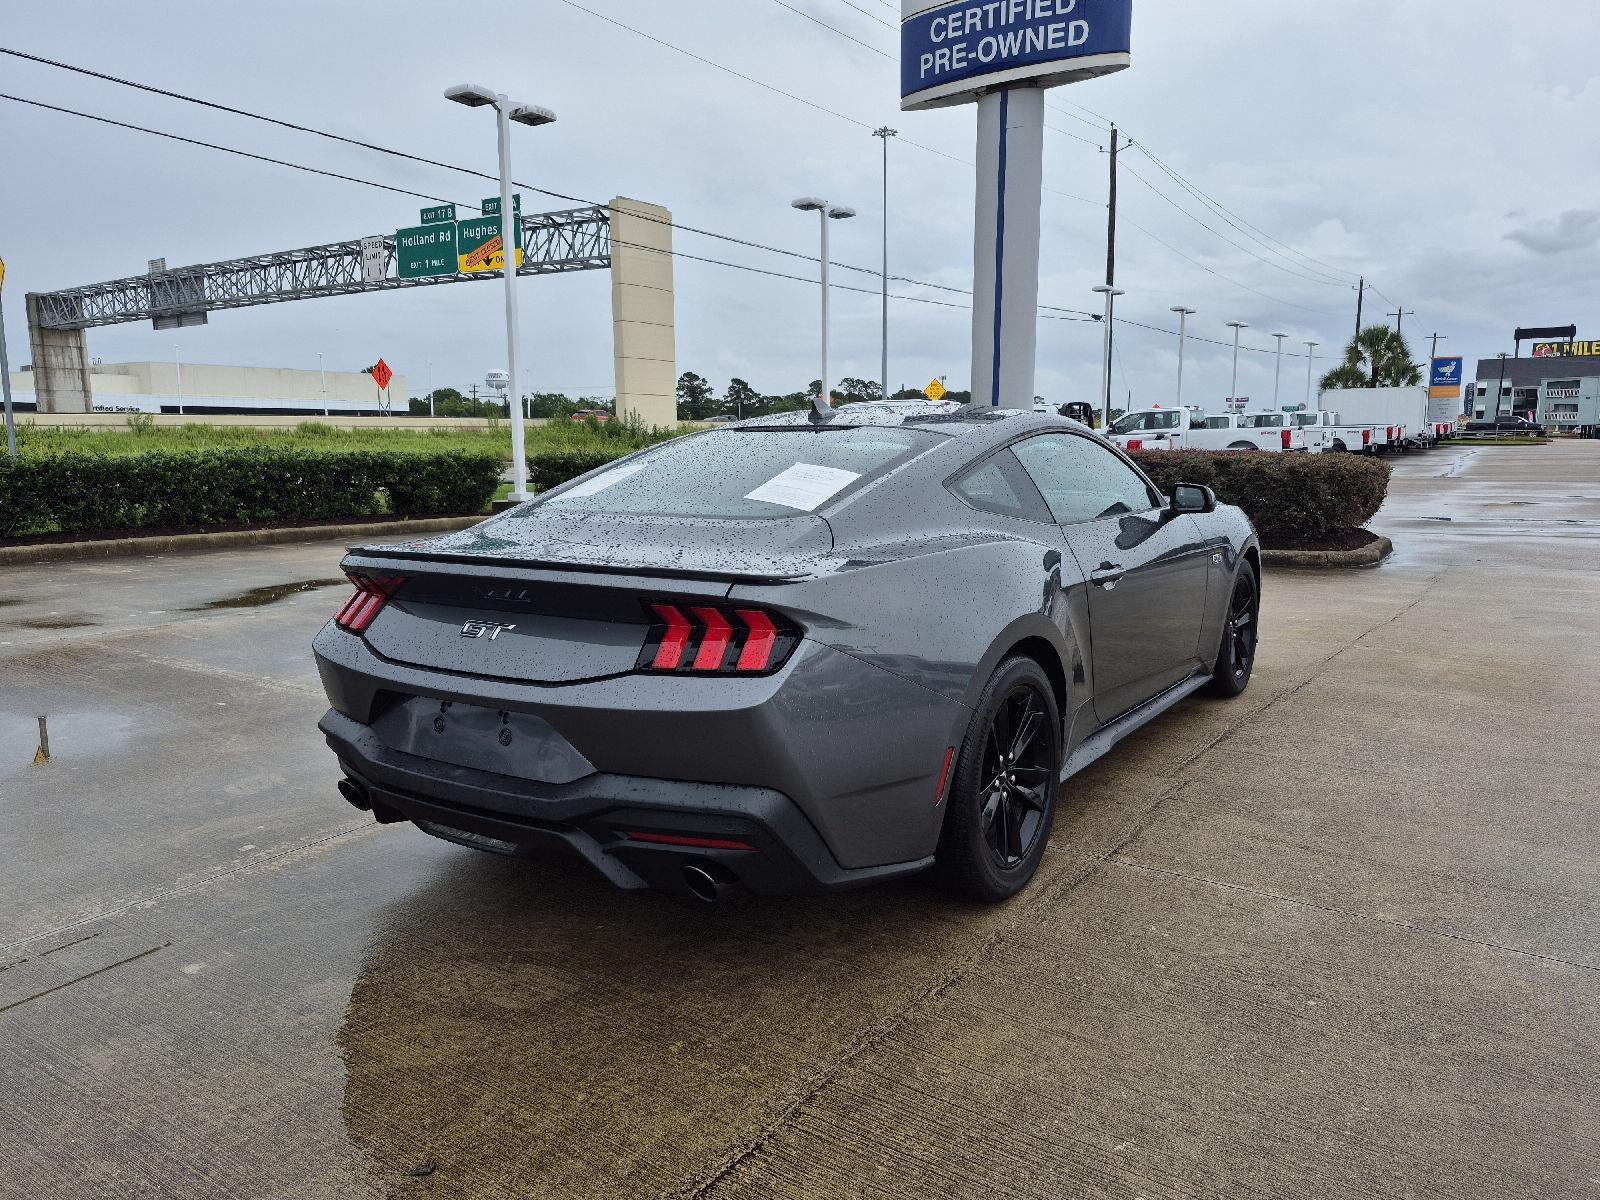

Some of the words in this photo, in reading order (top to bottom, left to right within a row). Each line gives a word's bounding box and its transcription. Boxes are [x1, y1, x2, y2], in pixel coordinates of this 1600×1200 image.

[930, 0, 1076, 43] CERTIFIED
[920, 19, 1090, 79] PRE-OWNED
[423, 211, 435, 220] EXIT
[437, 209, 446, 219] 17
[447, 207, 453, 218] B
[485, 202, 497, 211] EXIT
[402, 232, 435, 247] Holland
[439, 230, 451, 243] Rd
[463, 225, 498, 240] Hughes
[363, 240, 383, 250] SPEED
[365, 251, 381, 261] LIMIT
[410, 261, 422, 269] EXIT
[431, 258, 445, 267] MILE
[459, 619, 517, 641] GT
